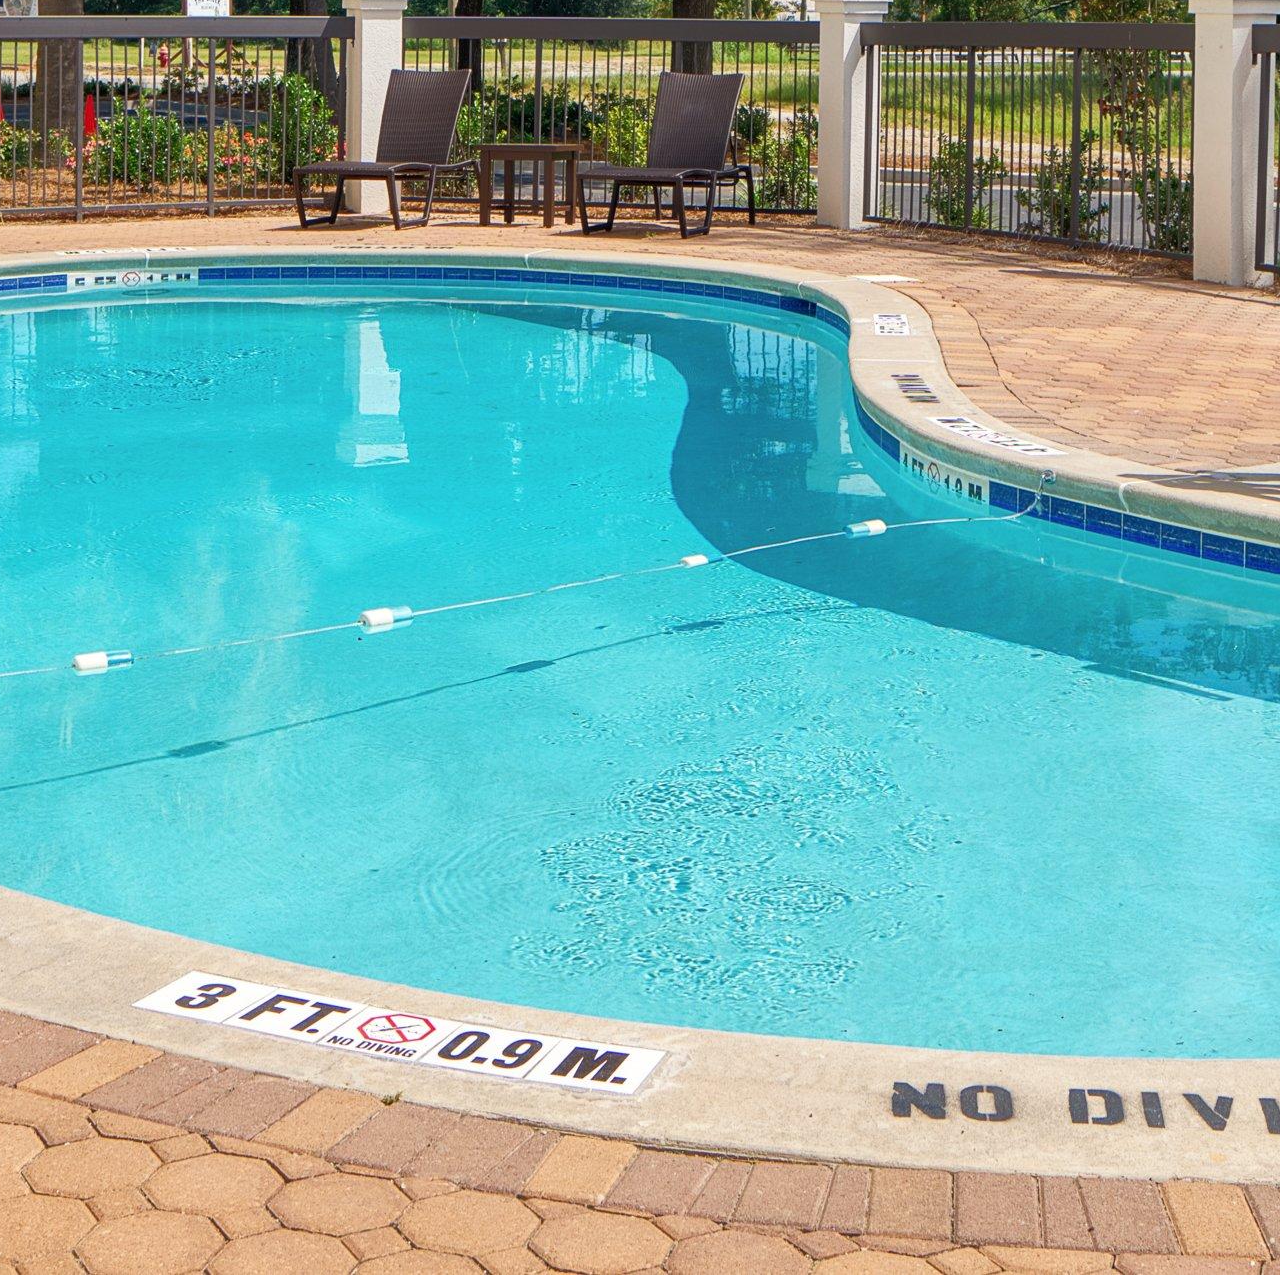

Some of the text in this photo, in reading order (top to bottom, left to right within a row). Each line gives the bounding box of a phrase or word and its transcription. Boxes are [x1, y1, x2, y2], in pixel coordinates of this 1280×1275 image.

[175, 983, 631, 1085] 3 FT. 0.9 M.
[326, 1035, 418, 1058] NO DIVING
[891, 1081, 1014, 1122] NO
